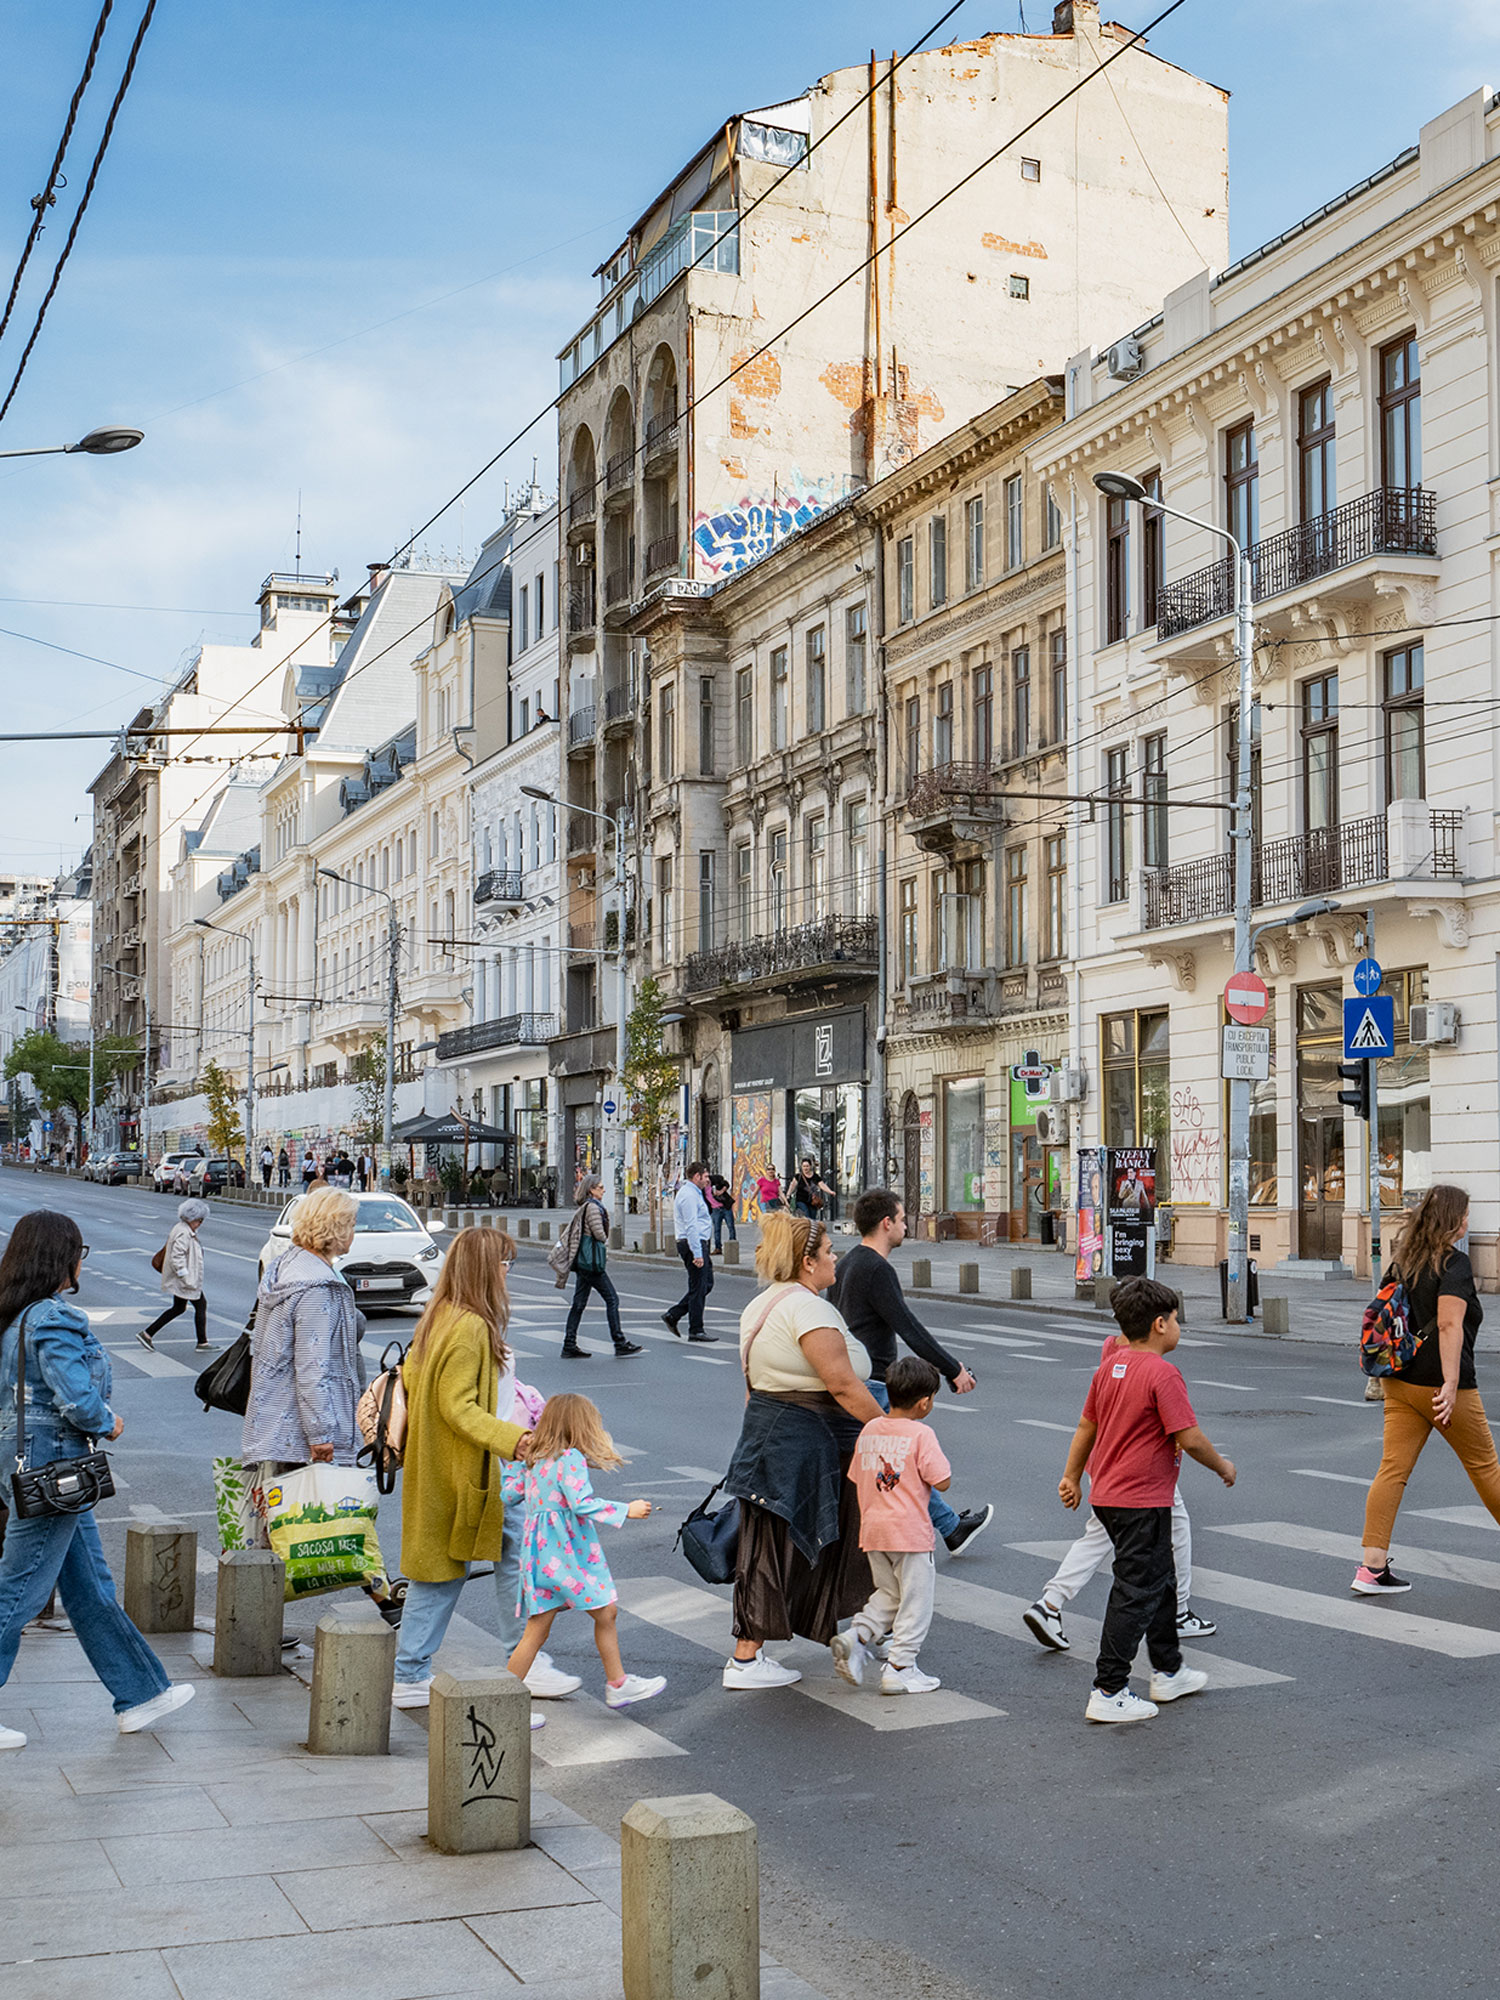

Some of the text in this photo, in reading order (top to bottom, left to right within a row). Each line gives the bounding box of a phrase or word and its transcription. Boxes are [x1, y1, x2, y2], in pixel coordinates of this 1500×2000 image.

[1228, 1030, 1236, 1040] CU
[1225, 1041, 1268, 1053] TRANSPORTULUI
[1236, 1054, 1256, 1064] PUBLIC
[1236, 1066, 1254, 1076] LOCAL
[1115, 1239, 1145, 1248] bringing
[1115, 1247, 1132, 1256] sexy
